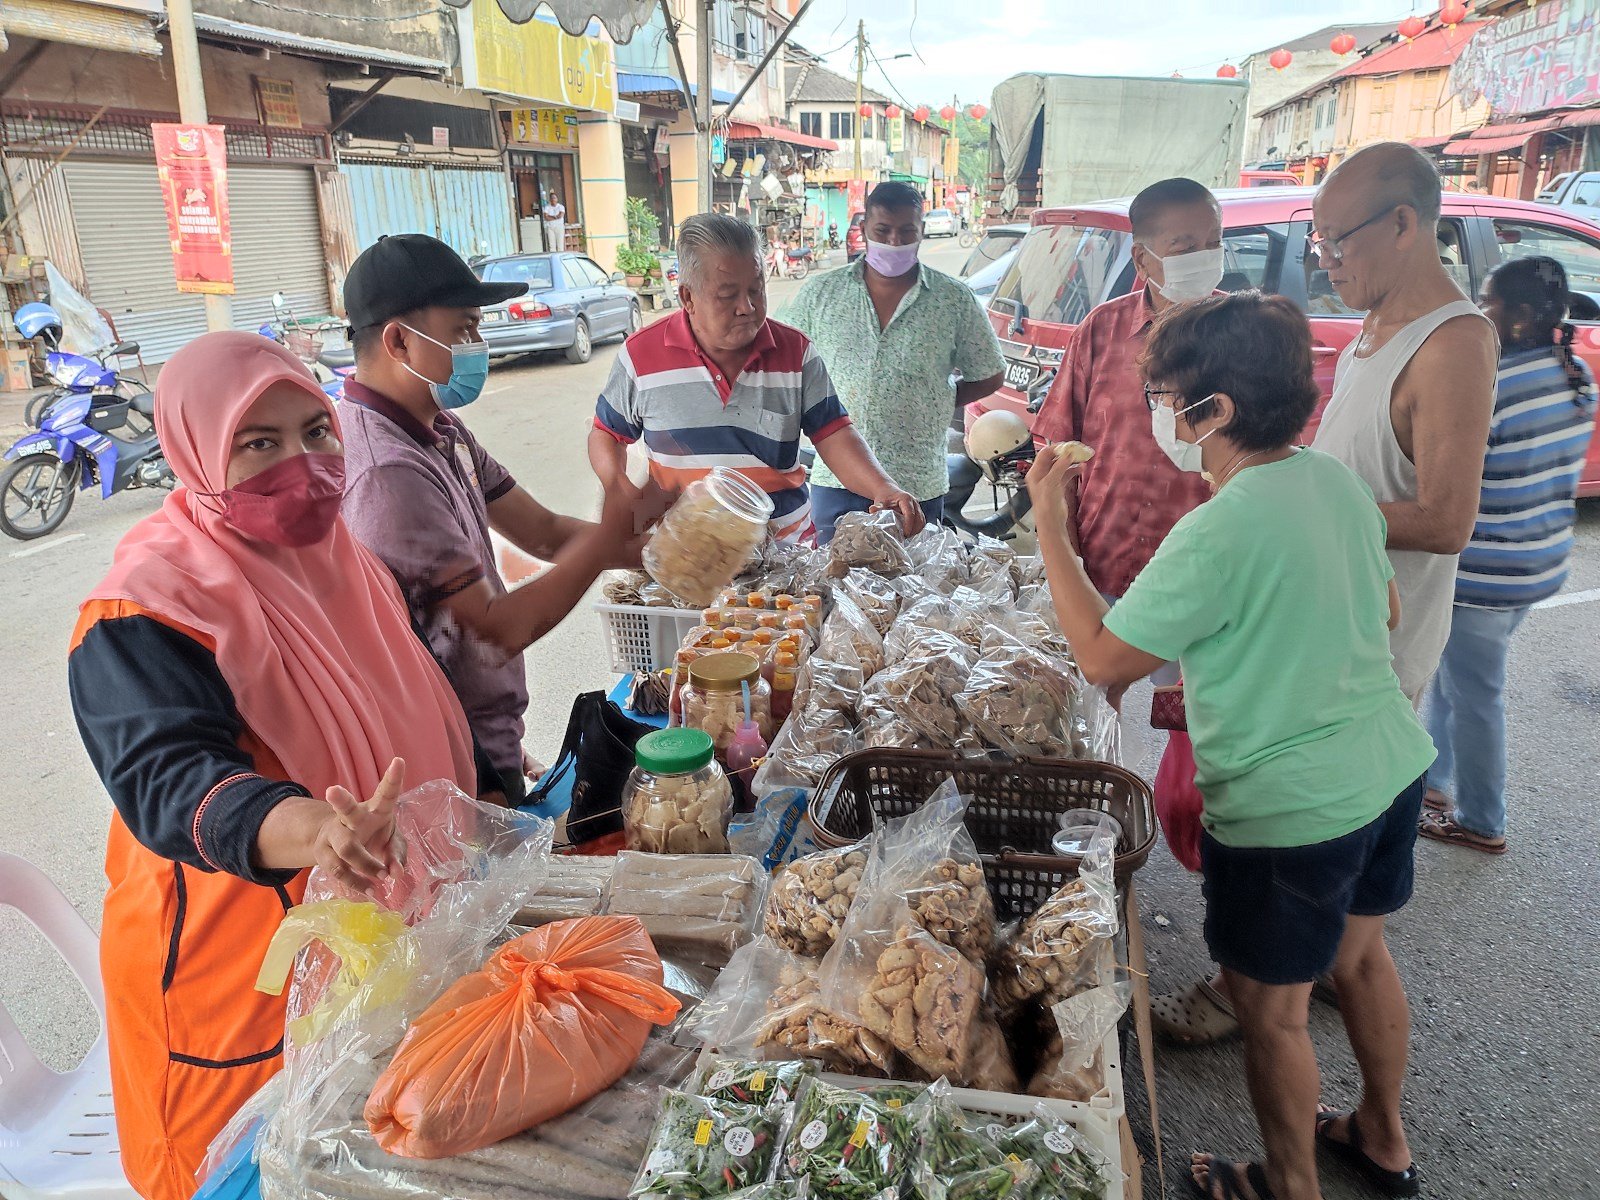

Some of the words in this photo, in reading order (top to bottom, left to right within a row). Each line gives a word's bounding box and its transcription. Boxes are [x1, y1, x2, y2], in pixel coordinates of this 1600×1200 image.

[567, 67, 585, 93] digi
[181, 205, 210, 215] selamat
[1010, 365, 1031, 386] 6935
